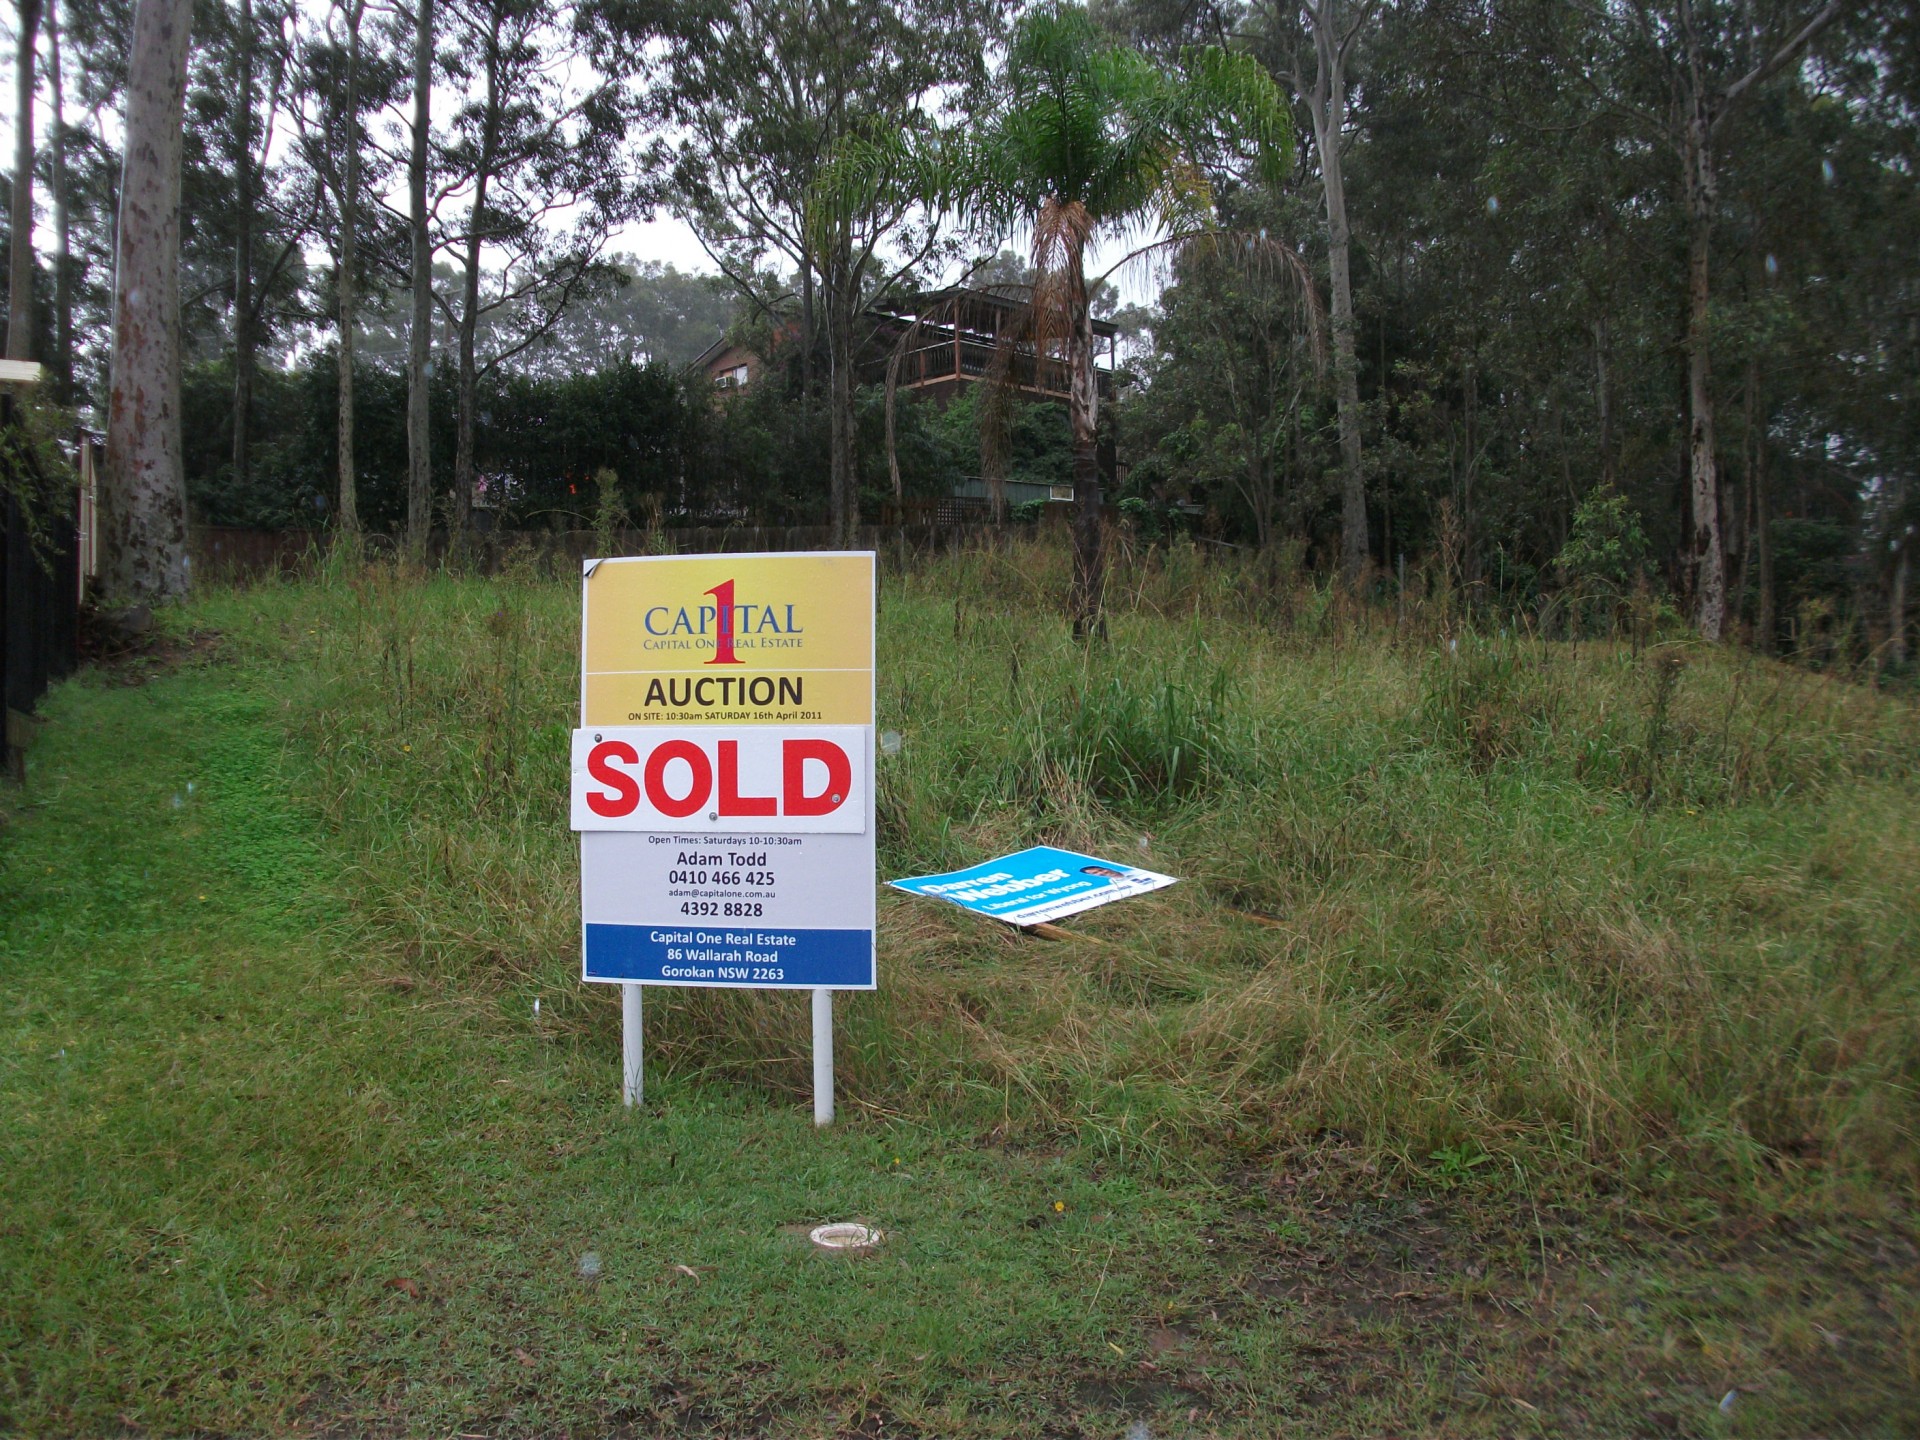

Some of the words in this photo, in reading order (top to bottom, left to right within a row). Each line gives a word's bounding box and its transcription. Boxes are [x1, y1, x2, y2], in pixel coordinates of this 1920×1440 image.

[644, 604, 803, 635] CAPITAL
[644, 677, 803, 706] AUCTION
[628, 712, 641, 721] ON
[643, 712, 664, 721] SITE:
[666, 712, 702, 720] 10:30am
[705, 711, 750, 720] SATURDAY
[753, 711, 773, 720] 16th
[776, 711, 798, 721] April
[800, 711, 822, 720] 2011
[586, 739, 852, 818] SOLD
[648, 836, 671, 846] Open
[673, 836, 701, 845] Times:
[703, 836, 746, 846] Saturdays
[749, 837, 802, 846] 10-10:30am
[676, 851, 723, 866] Adam
[728, 852, 767, 867] Todd
[669, 870, 707, 885] 0410
[711, 871, 741, 886] 466
[745, 872, 775, 886] 425
[917, 872, 1014, 893] Darren
[944, 869, 1071, 902] Webber
[668, 889, 776, 899] adam@capitalone.com.au
[680, 901, 719, 916] 4392
[723, 902, 763, 917] 8828
[650, 931, 693, 945] Capital
[696, 932, 722, 944] One
[726, 933, 753, 945] Real
[756, 934, 797, 946] Estate
[667, 948, 683, 960] 86
[686, 948, 742, 962] Wallarah
[745, 950, 778, 963] Road
[662, 965, 714, 979] Gorokan
[718, 967, 749, 979] NSW
[753, 967, 784, 980] 2263
